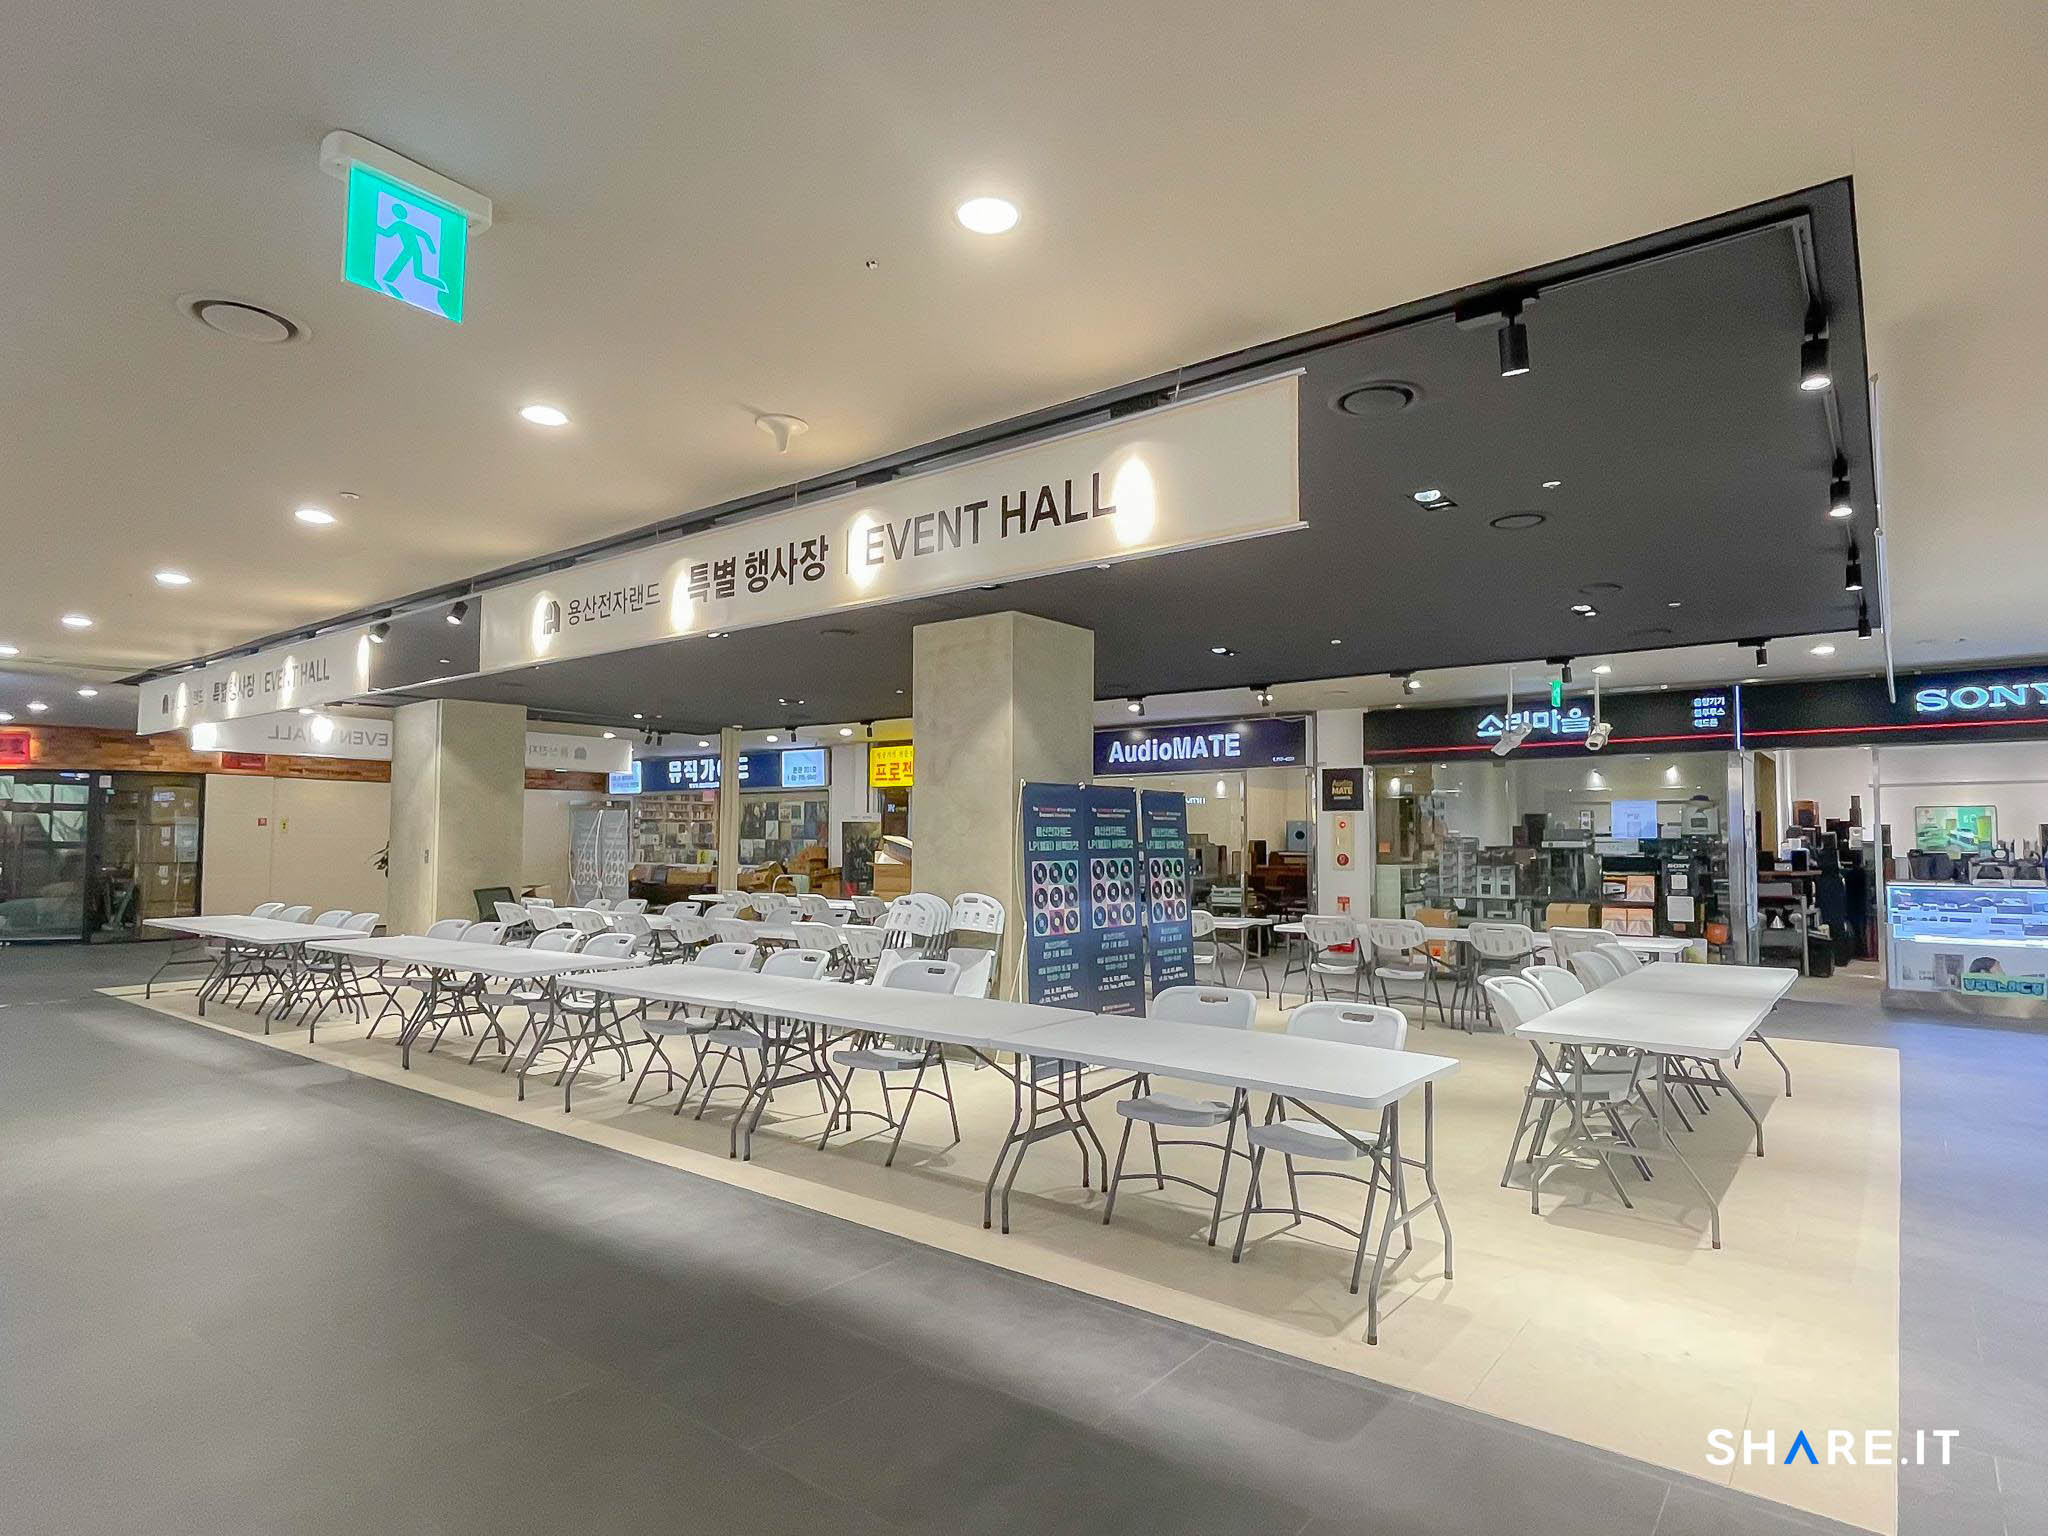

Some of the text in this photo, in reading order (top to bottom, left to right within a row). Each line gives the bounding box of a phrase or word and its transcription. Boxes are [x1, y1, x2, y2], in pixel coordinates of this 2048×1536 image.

[865, 472, 1117, 566] EVENT HALL
[687, 534, 829, 603] 특별 행사장
[567, 582, 661, 626] 용산전자랜드
[264, 658, 330, 693] EVET HALL
[1476, 707, 1593, 738] 소리마을
[1108, 733, 1241, 764] AudioMATE
[668, 756, 750, 784] 뮤직가드
[1331, 786, 1353, 796] MATE
